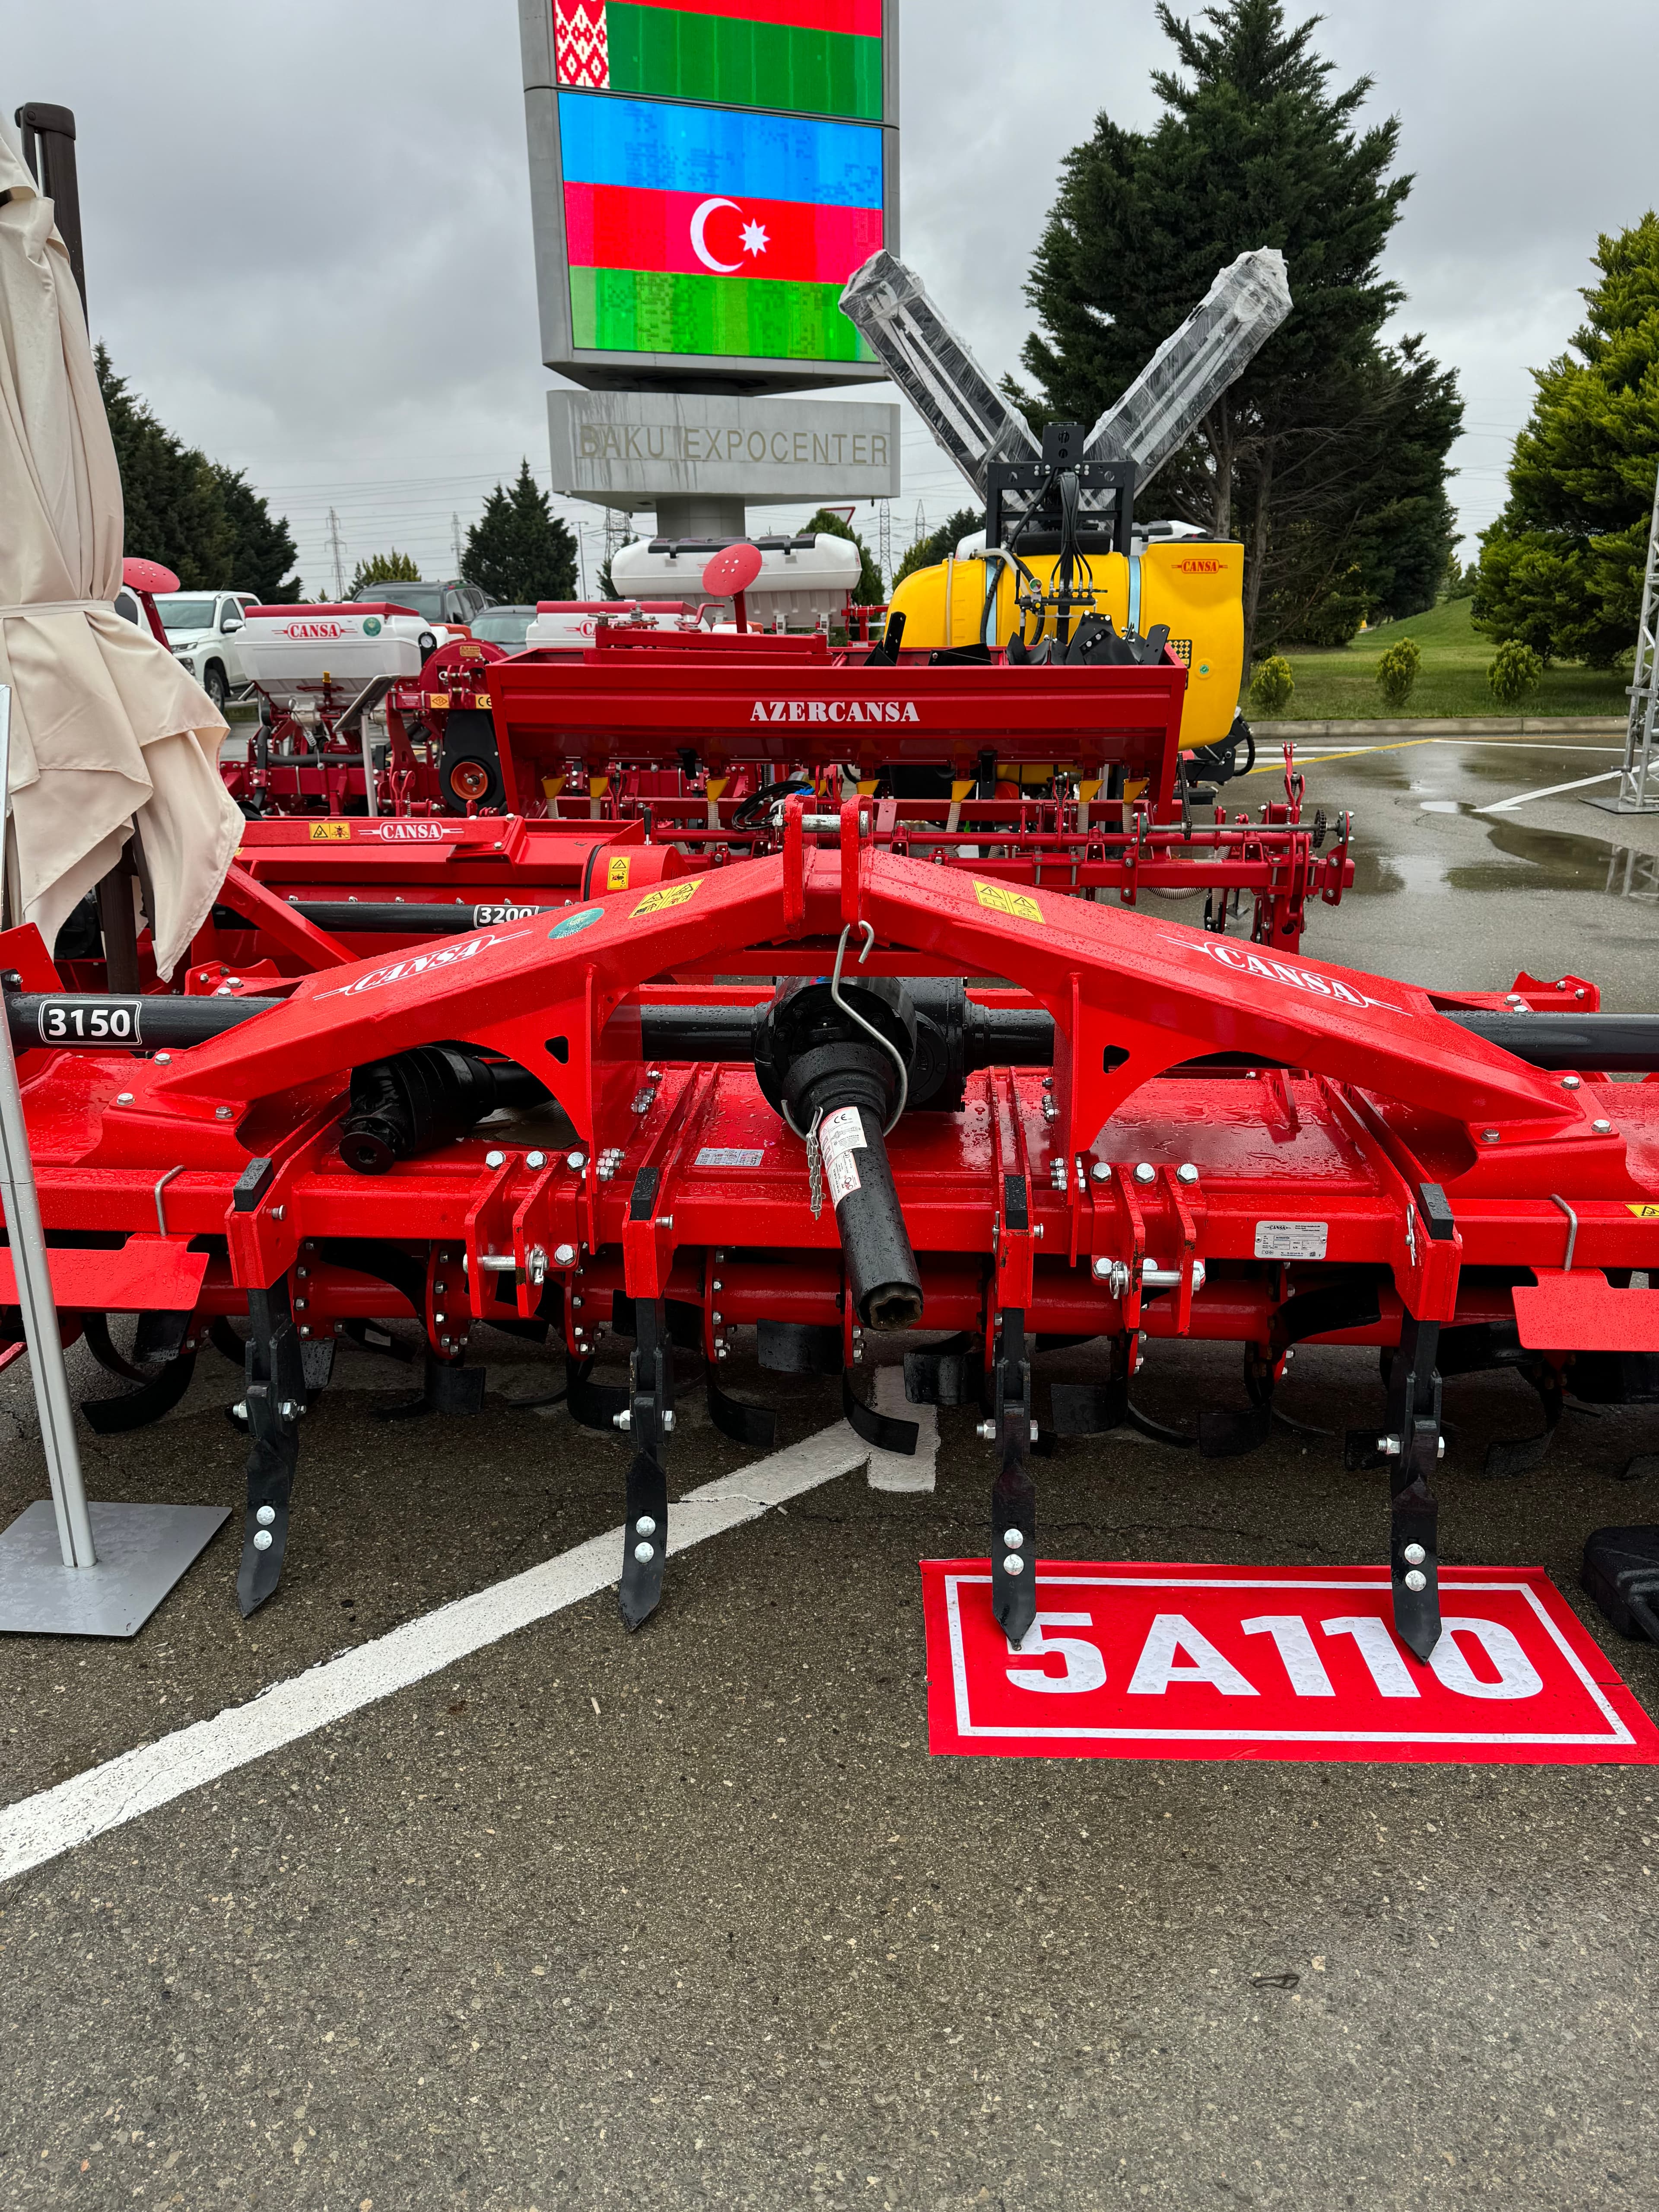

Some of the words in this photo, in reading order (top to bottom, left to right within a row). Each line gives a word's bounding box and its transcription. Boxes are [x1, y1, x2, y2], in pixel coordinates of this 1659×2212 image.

[580, 425, 664, 458] BAKU
[686, 427, 887, 465] EXPOCENTER
[1183, 561, 1217, 572] CANSA
[290, 624, 338, 637] CANSA
[750, 701, 920, 722] AZERCANSA
[383, 824, 440, 839] CANSA
[479, 907, 532, 923] 3200
[355, 939, 482, 991] CANSA
[1214, 947, 1363, 1004] CANSA
[49, 1009, 130, 1036] 3150
[1006, 1611, 1544, 1699] 5A110
